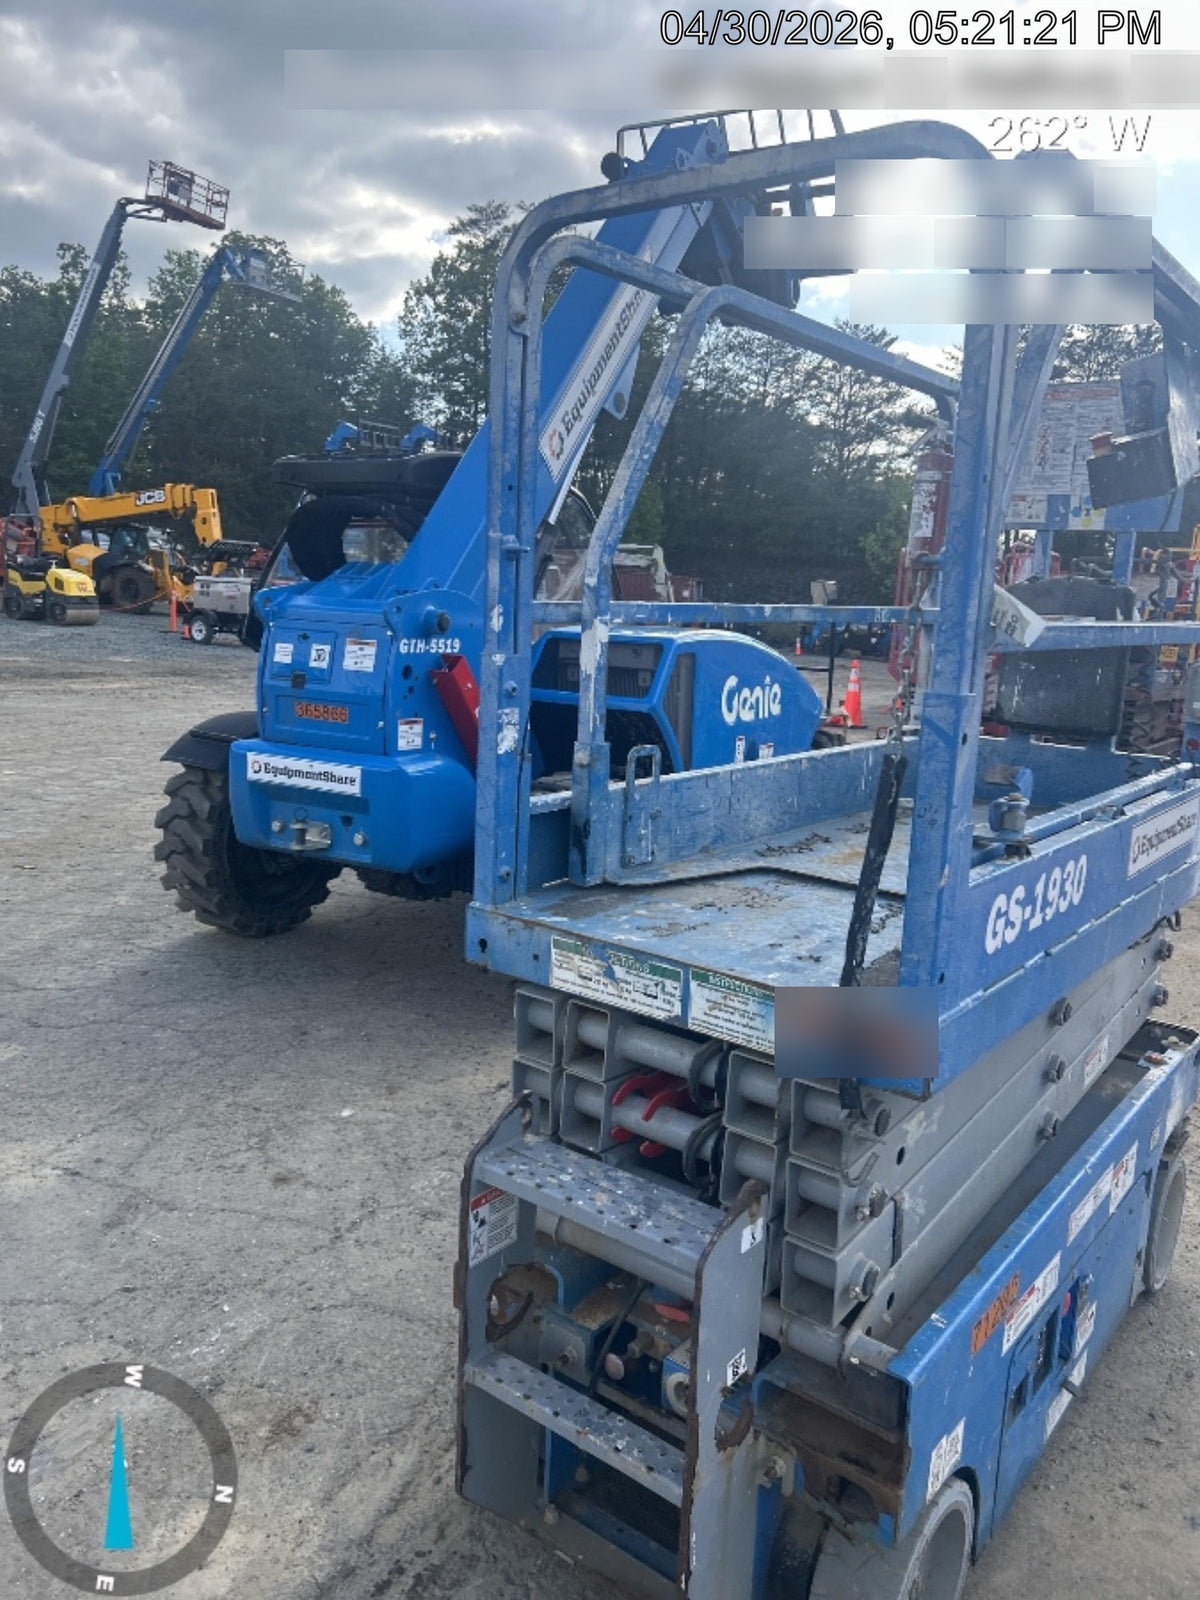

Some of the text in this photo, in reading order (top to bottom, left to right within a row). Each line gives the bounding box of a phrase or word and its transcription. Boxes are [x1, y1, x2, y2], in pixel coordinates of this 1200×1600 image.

[135, 490, 166, 506] JCB
[399, 637, 461, 654] GTH-5519
[721, 675, 782, 726] Genie
[263, 762, 357, 787] EquipmentShare
[985, 854, 1088, 955] GS-1930
